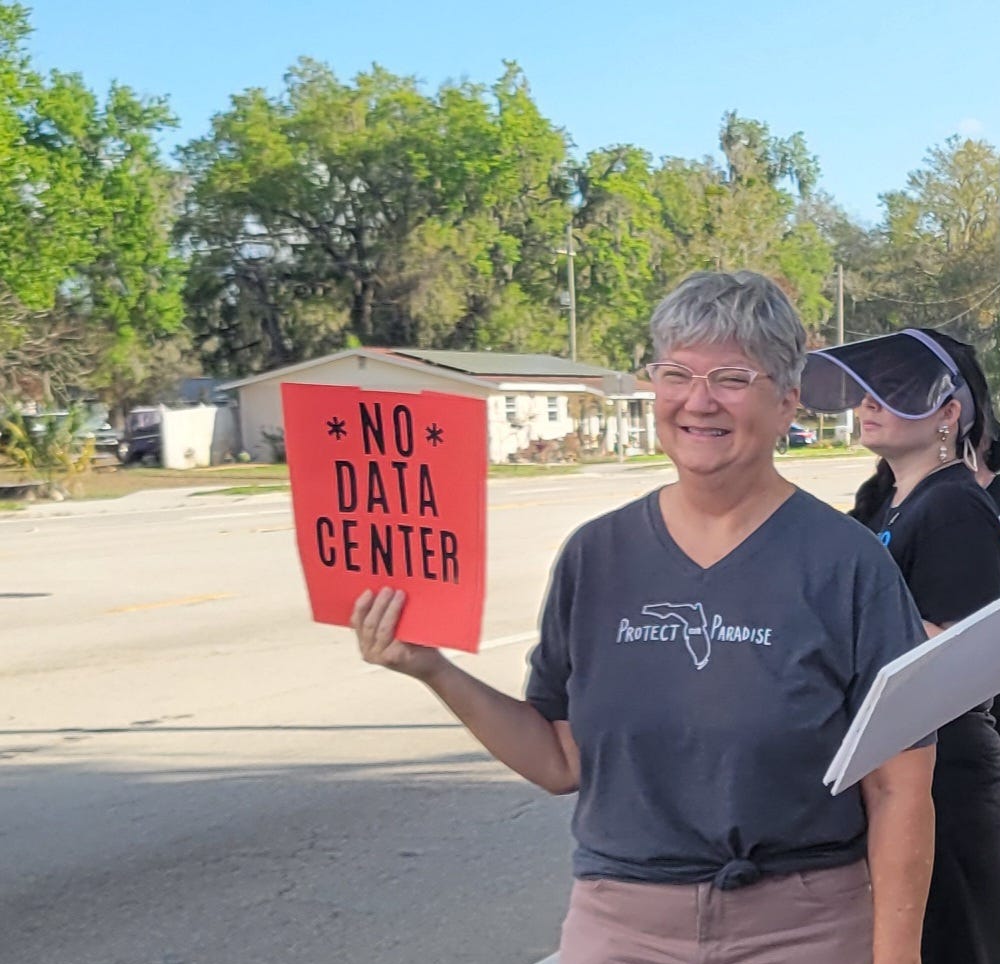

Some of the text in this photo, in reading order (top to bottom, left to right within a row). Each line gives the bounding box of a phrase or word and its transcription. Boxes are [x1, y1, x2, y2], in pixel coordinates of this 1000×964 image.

[359, 402, 414, 457] NO
[335, 460, 438, 517] DATA
[316, 516, 460, 584] CENTER
